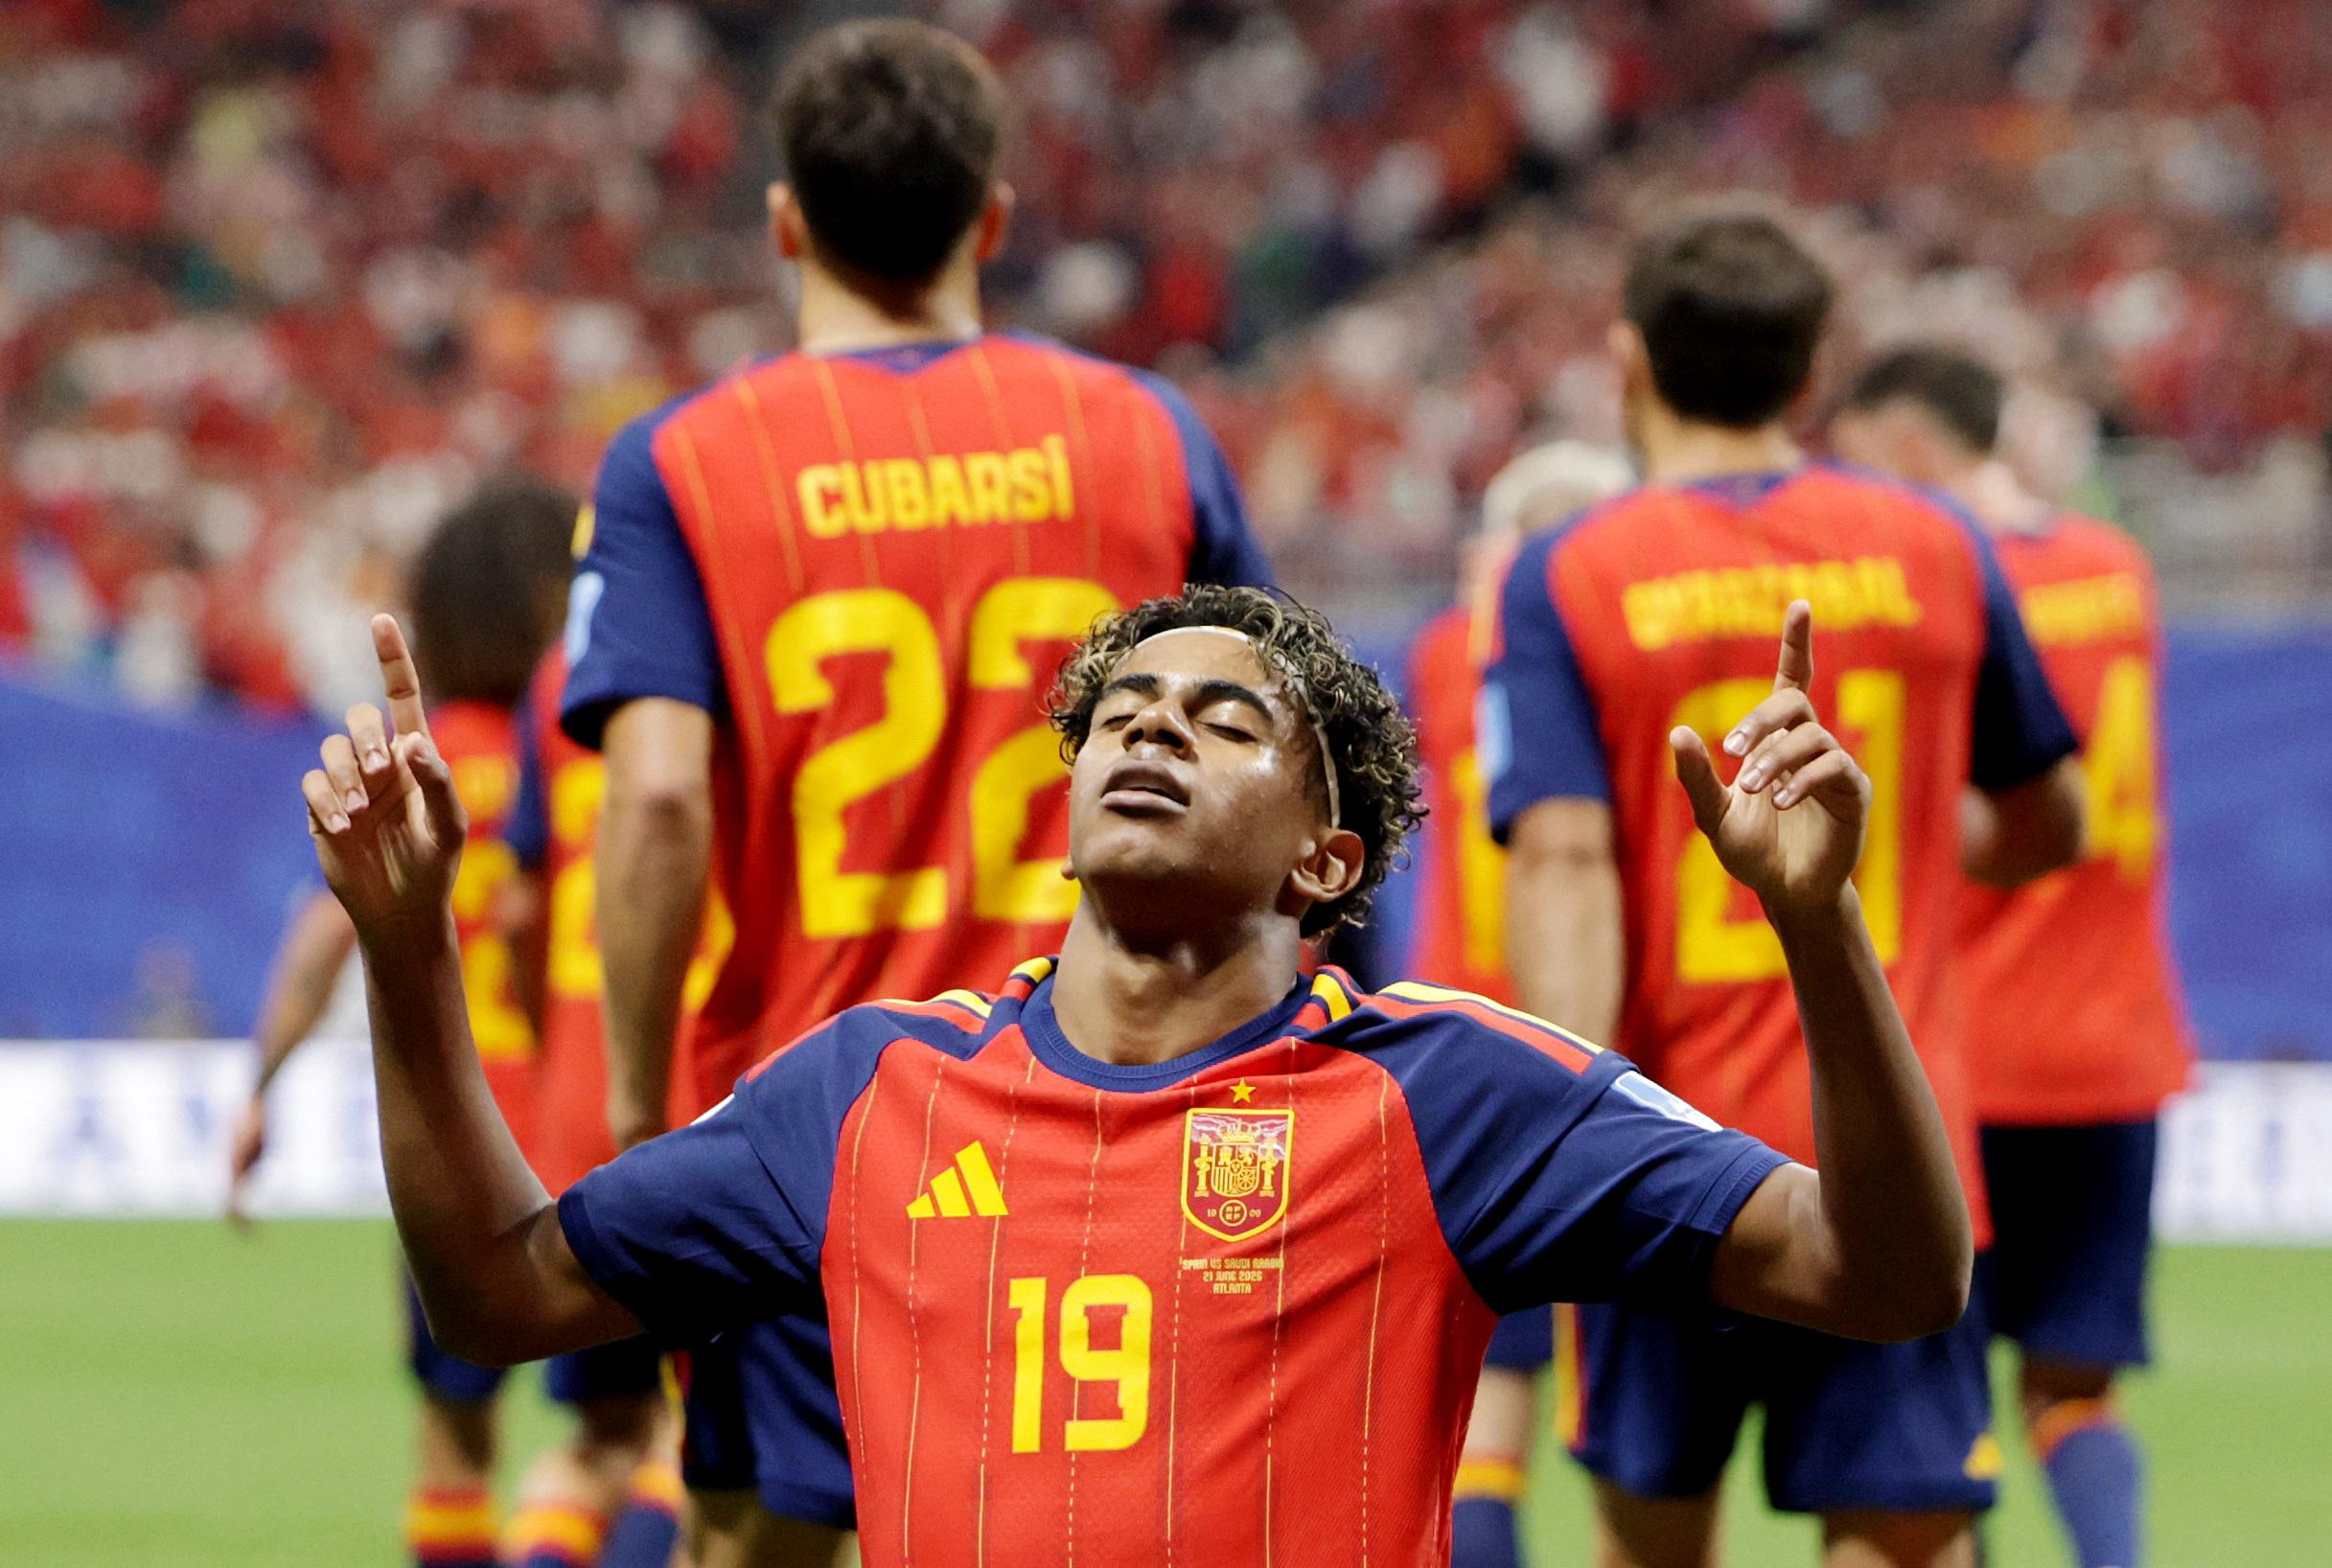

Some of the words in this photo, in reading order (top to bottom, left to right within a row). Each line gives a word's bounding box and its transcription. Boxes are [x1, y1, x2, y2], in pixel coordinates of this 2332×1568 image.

[797, 434, 1074, 539] CUBARSÍ
[766, 576, 1120, 939] 22
[1182, 1258, 1208, 1270] SPAIN
[1203, 1271, 1212, 1281] 21
[1215, 1271, 1236, 1281] JUNE
[1238, 1270, 1262, 1281] 2026
[1212, 1282, 1252, 1294] ATLANTA
[1008, 1274, 1153, 1453] 19
